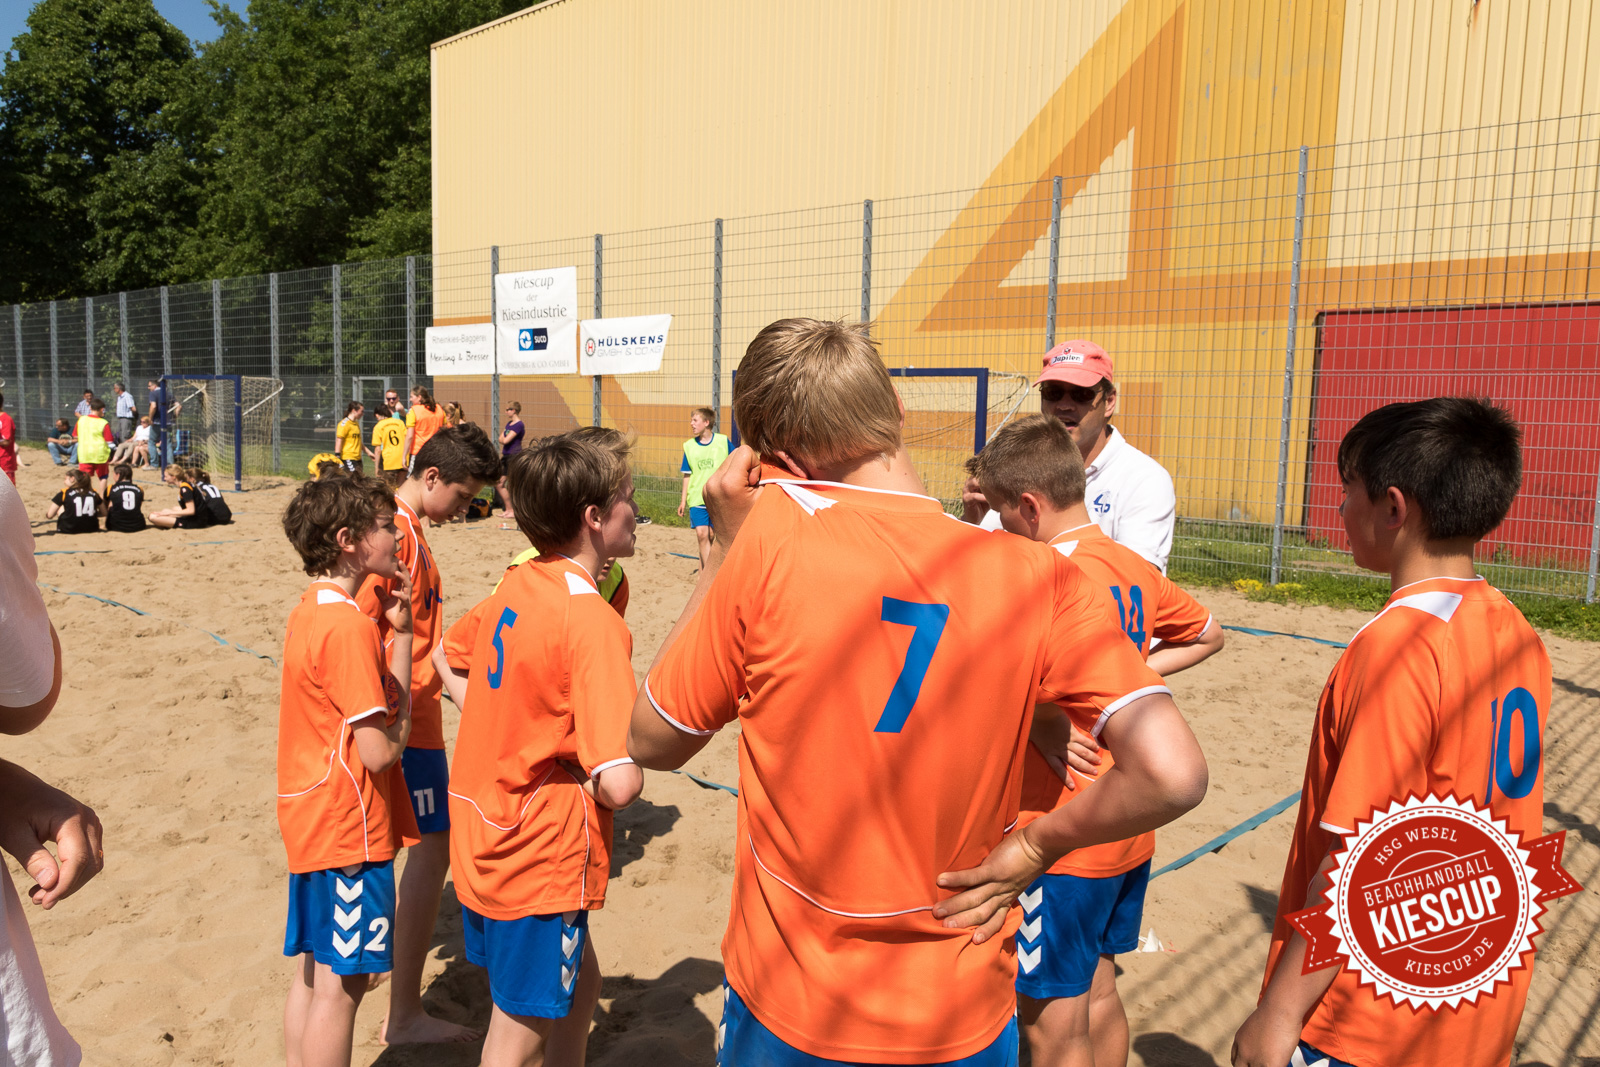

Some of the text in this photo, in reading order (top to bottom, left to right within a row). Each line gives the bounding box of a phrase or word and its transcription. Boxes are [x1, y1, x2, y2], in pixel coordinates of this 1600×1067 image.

[513, 276, 554, 290] Kiescup
[526, 294, 538, 302] der
[502, 304, 567, 321] Kiesindustrie
[534, 335, 547, 343] SUCO
[597, 335, 664, 347] HÜLSKENS
[548, 360, 570, 368] GMBH
[388, 429, 400, 447] 6
[73, 496, 95, 517] 14
[487, 606, 518, 689] 5
[873, 595, 950, 733] 7
[1484, 686, 1541, 806] 10
[413, 787, 435, 816] 11
[364, 917, 389, 952] 2
